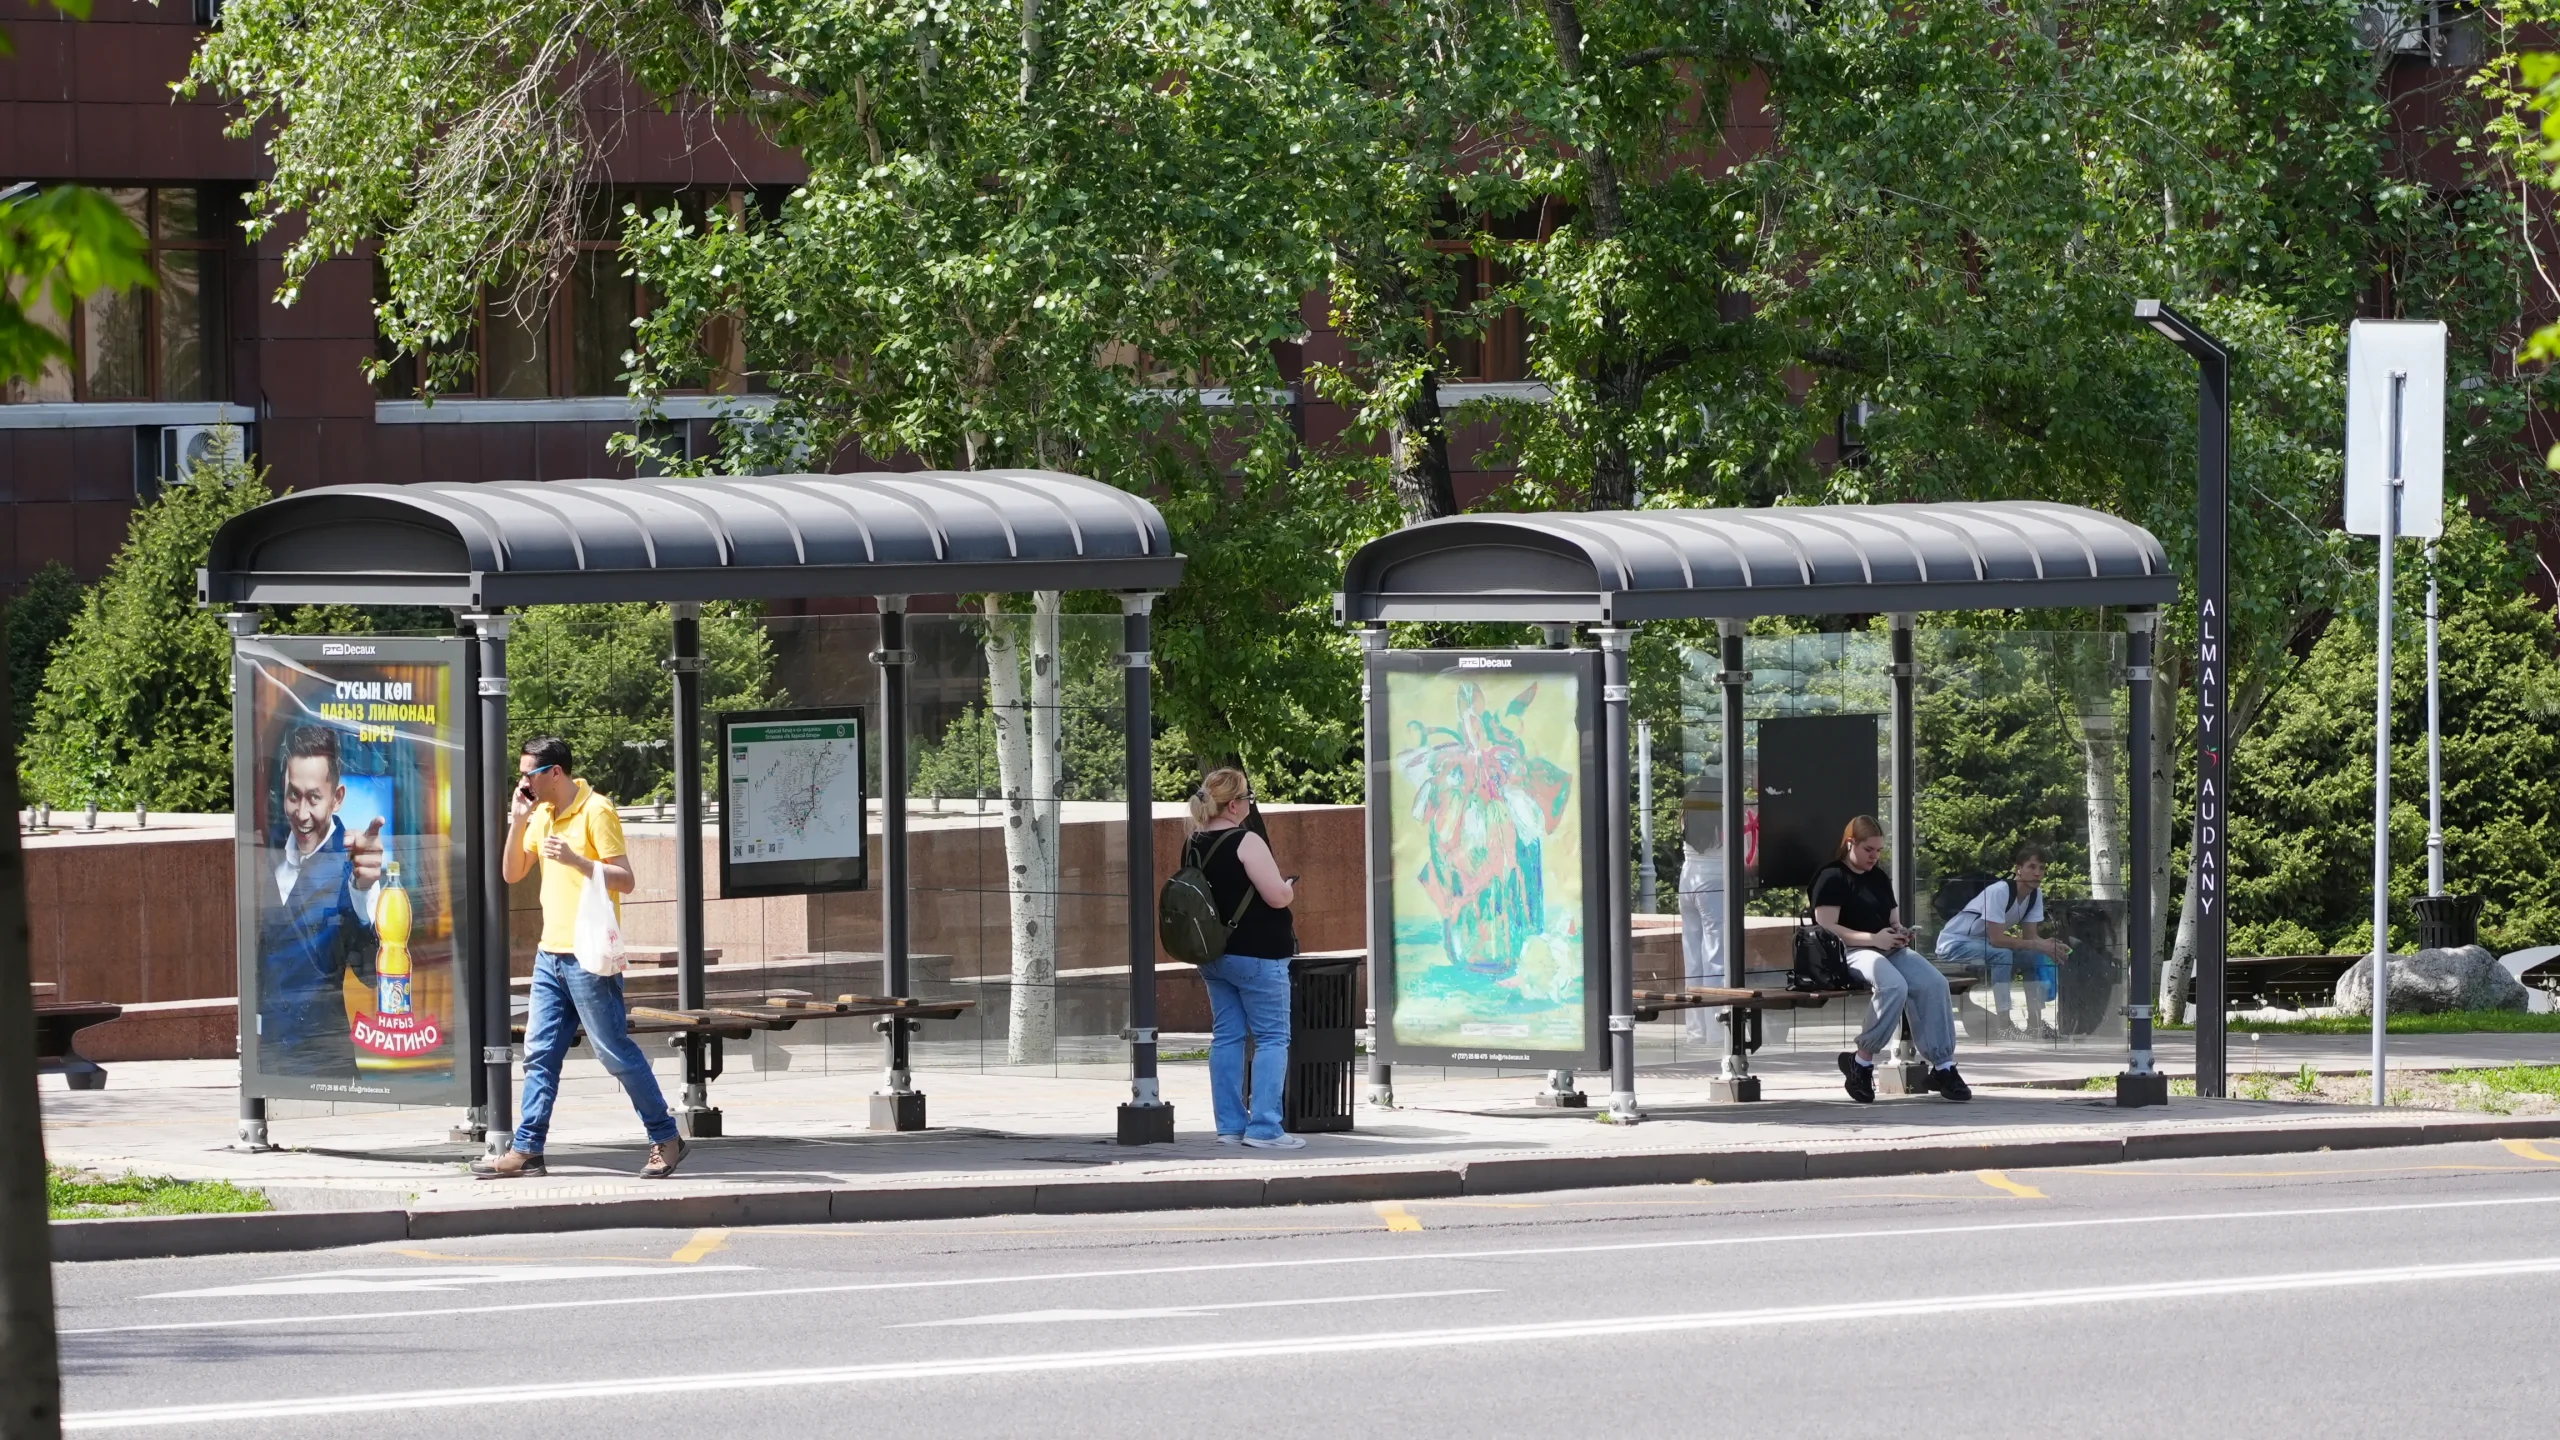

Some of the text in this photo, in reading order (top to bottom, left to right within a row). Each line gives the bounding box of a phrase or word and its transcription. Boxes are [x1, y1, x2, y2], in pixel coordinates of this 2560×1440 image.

[2201, 598, 2217, 733] ALMALY
[336, 681, 413, 701] СУСЫН КӨП
[368, 704, 436, 725] ЛИМОНАД
[2201, 778, 2216, 915] AUDANY
[354, 1020, 437, 1052] БУРАТИНО
